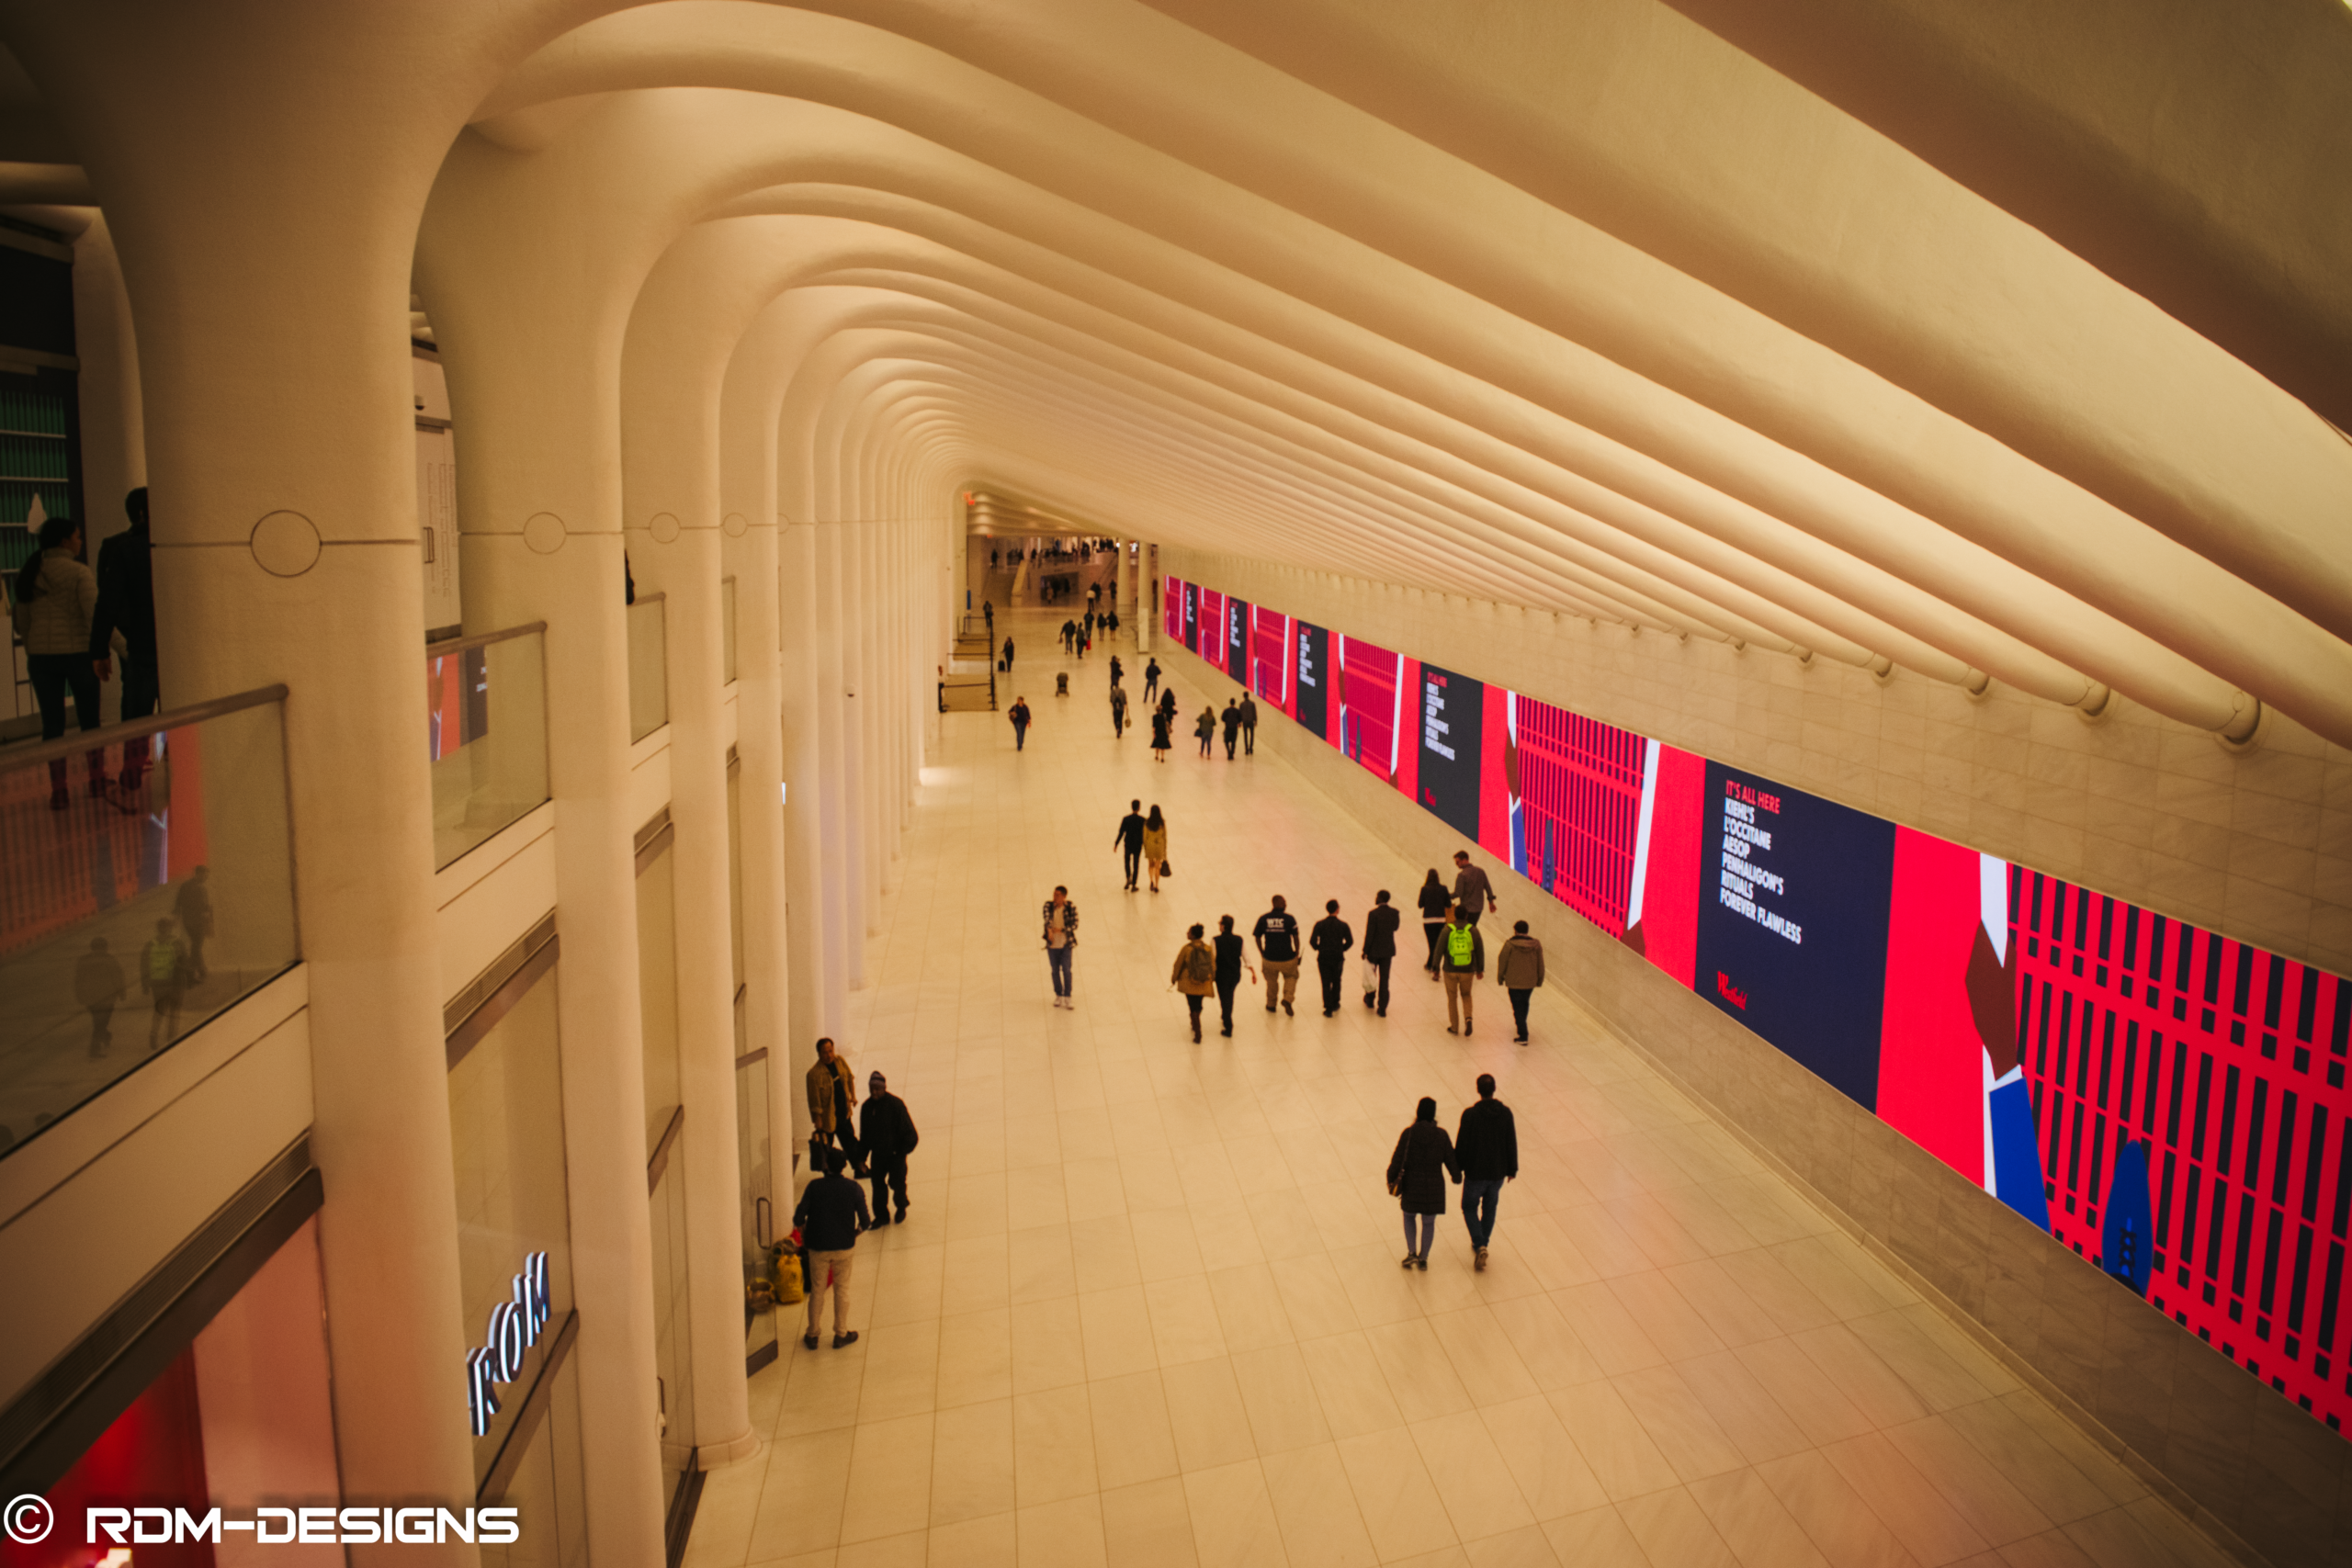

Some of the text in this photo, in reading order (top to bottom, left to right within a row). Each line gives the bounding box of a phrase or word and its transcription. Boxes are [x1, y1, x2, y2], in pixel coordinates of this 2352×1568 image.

[1724, 797, 1755, 824] KIEHL'S
[1726, 780, 1781, 815] IT'S ALL HERE
[1722, 834, 1750, 859] AESOP
[1724, 816, 1771, 851] L'OCCITANE
[1721, 869, 1754, 900] RITUALS
[1722, 851, 1784, 896] PENHALIGON'S
[1720, 886, 1802, 944] FOREVER FLAWLESS
